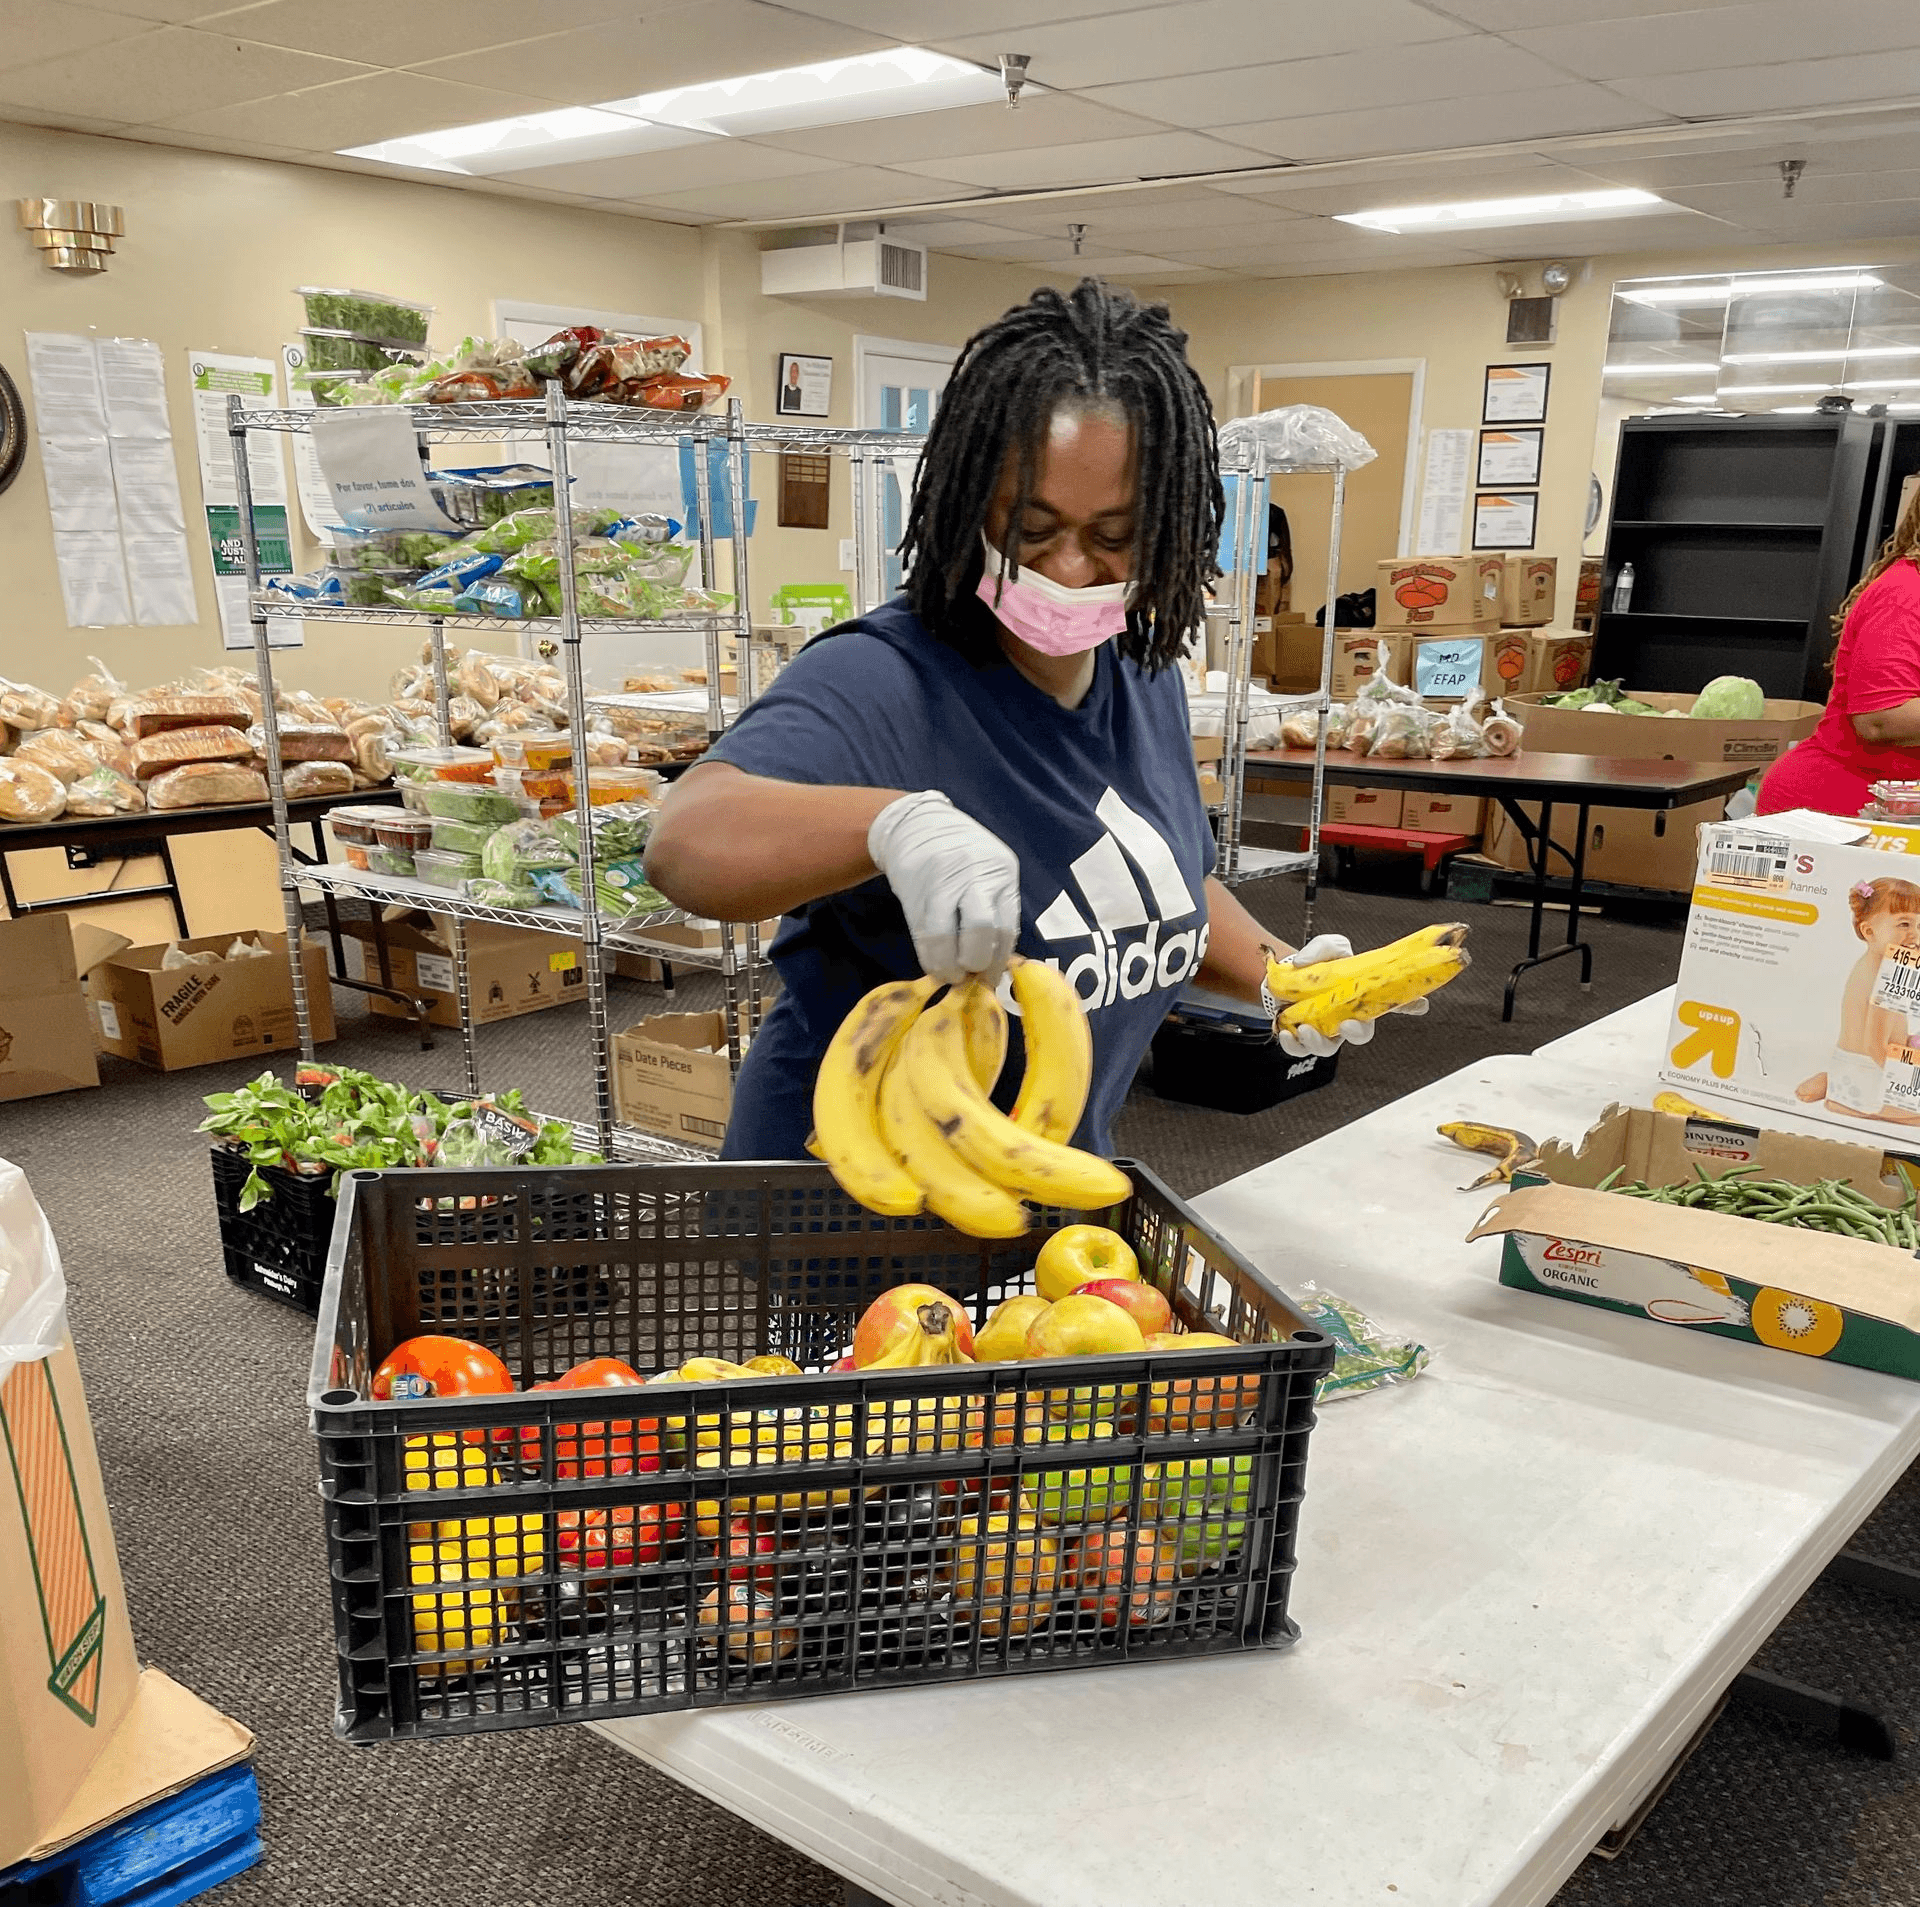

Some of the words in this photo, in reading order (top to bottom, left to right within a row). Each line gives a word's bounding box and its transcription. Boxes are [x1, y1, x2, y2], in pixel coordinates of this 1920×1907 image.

[336, 482, 351, 493] Por
[400, 478, 416, 488] dos
[221, 539, 241, 548] AND
[1789, 880, 1829, 896] hannels
[161, 974, 203, 1018] FRAGILE
[635, 1050, 657, 1066] Date
[660, 1056, 692, 1074] Pieces
[1900, 1049, 1914, 1065] ML
[1667, 1071, 1701, 1084] ECONOMY
[1701, 1079, 1719, 1089] PLUS
[1720, 1083, 1739, 1093] PACK
[486, 1111, 527, 1139] BASIL
[1543, 1235, 1602, 1265] Zespri
[1543, 1268, 1599, 1289] ORGANIC
